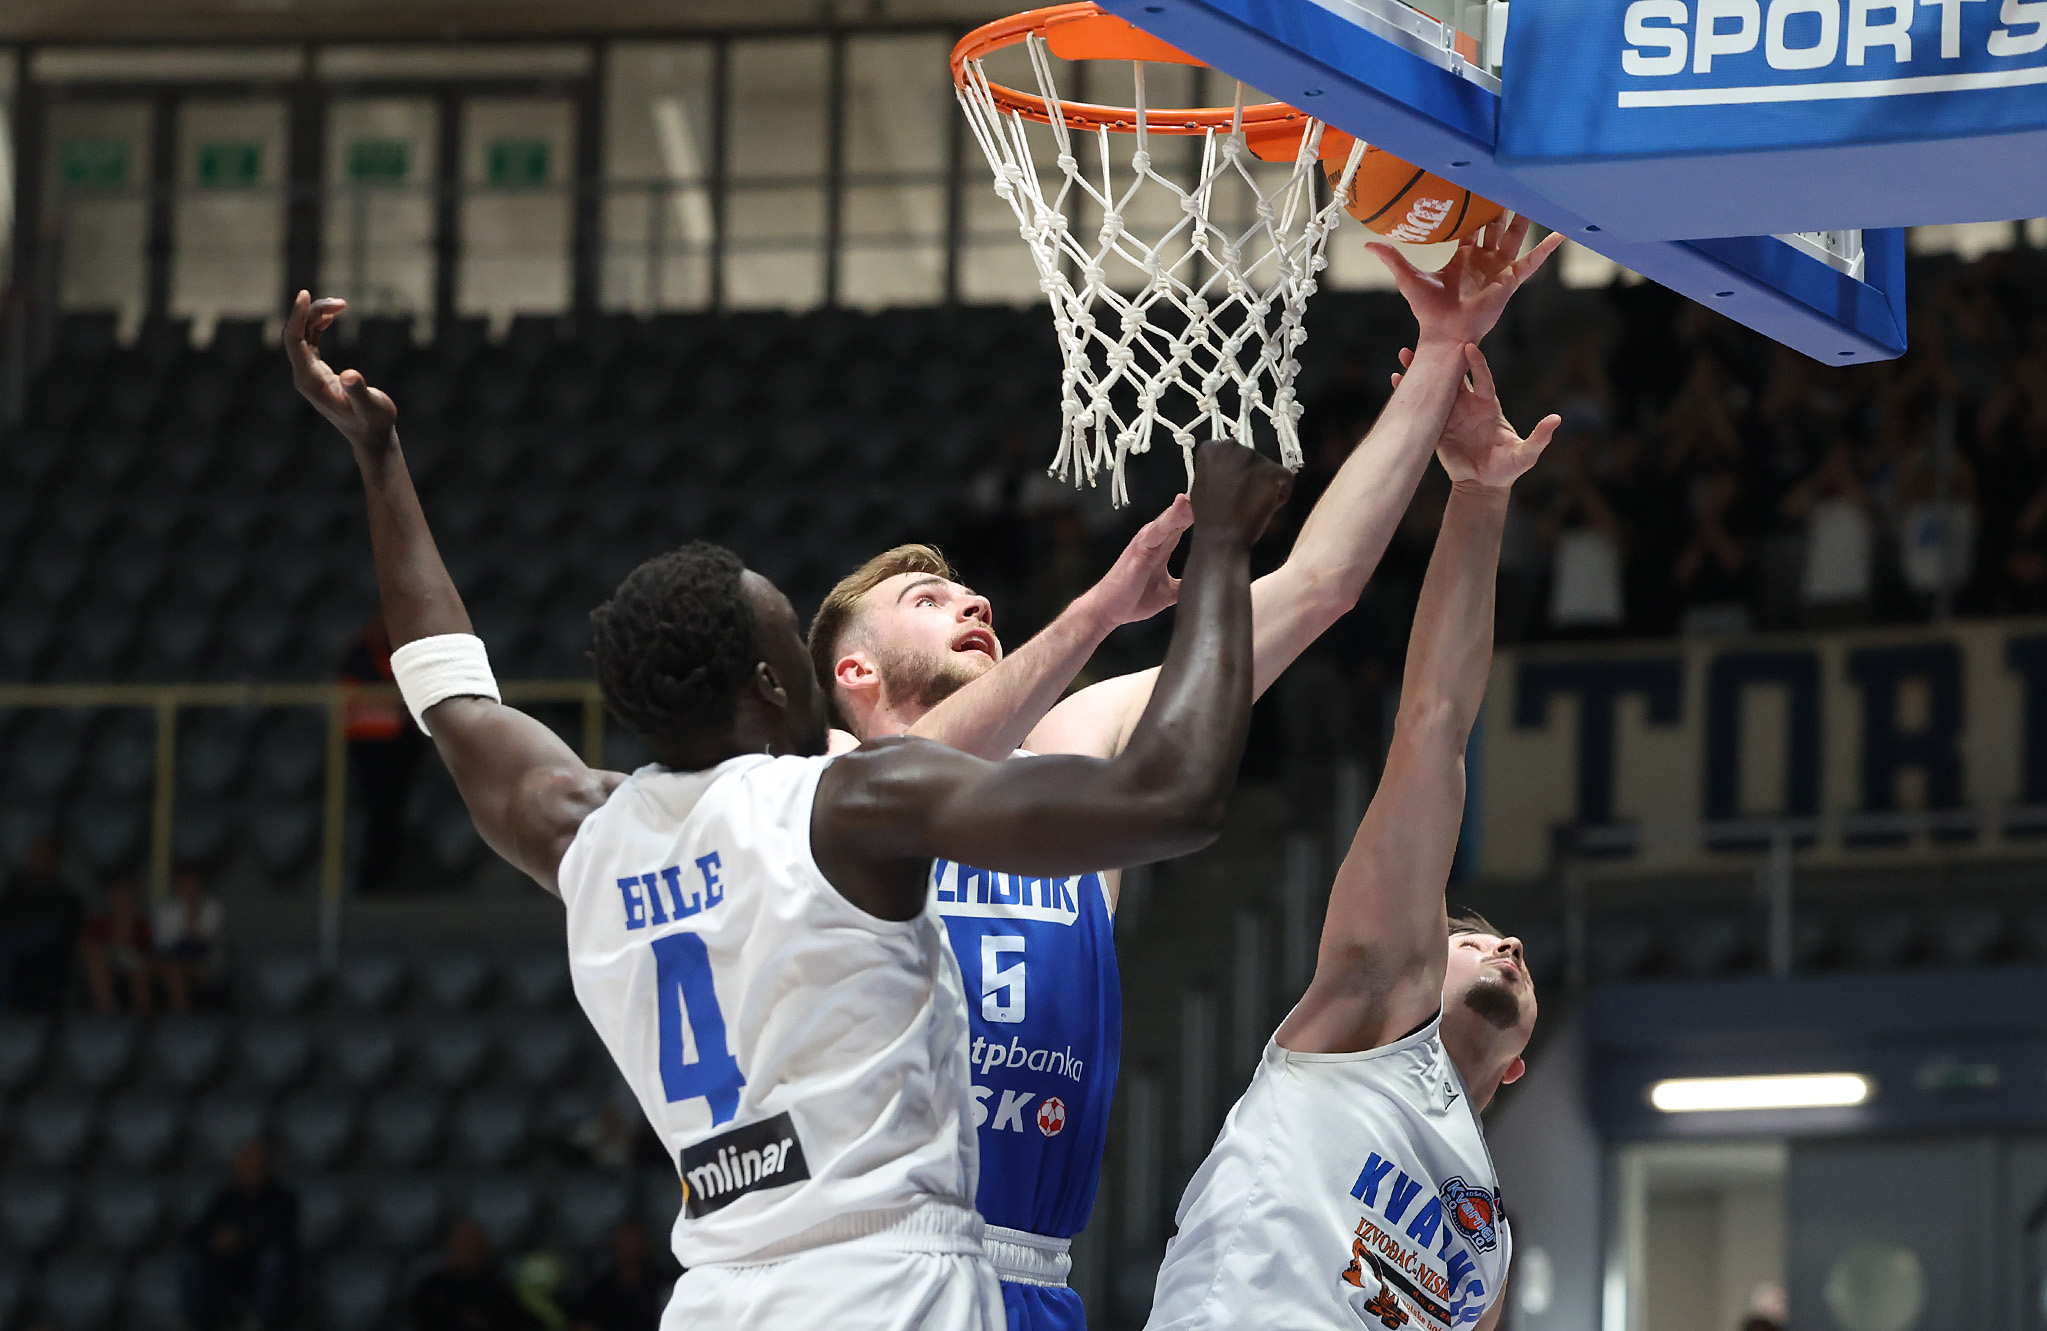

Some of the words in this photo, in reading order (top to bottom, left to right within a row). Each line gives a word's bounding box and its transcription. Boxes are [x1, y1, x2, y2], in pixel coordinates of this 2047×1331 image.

[1513, 637, 2047, 857] TOR
[981, 935, 1025, 1023] 5
[651, 932, 746, 1129] 4
[971, 1036, 1083, 1082] tpbanka
[970, 1085, 1036, 1132] SK
[687, 1138, 793, 1200] mlinar
[1447, 1181, 1496, 1243] Kvarner
